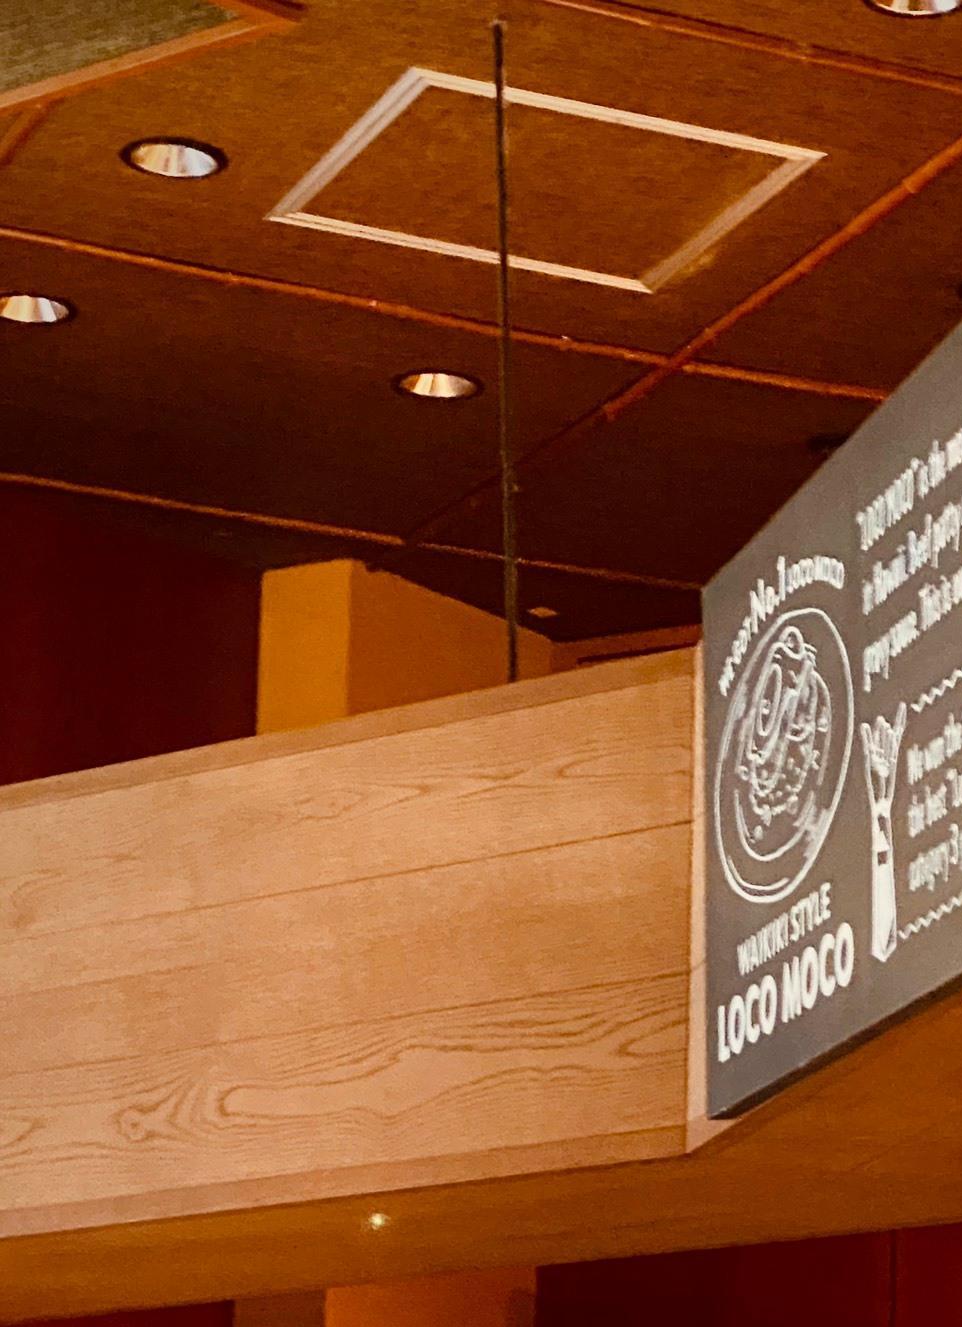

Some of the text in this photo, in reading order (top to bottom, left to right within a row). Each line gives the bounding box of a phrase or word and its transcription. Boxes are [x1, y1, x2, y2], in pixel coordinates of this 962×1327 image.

[916, 464, 931, 499] is
[927, 440, 948, 488] the
[908, 513, 932, 575] Beef
[930, 502, 962, 569] patty
[749, 555, 788, 634] No.1
[918, 583, 942, 632] This
[939, 575, 954, 617] is
[907, 795, 926, 838] the
[922, 783, 948, 827] best
[947, 823, 960, 865] 3
[736, 882, 832, 976] WAIKIKI STYLE
[717, 922, 855, 1063] LOCO MOCO
